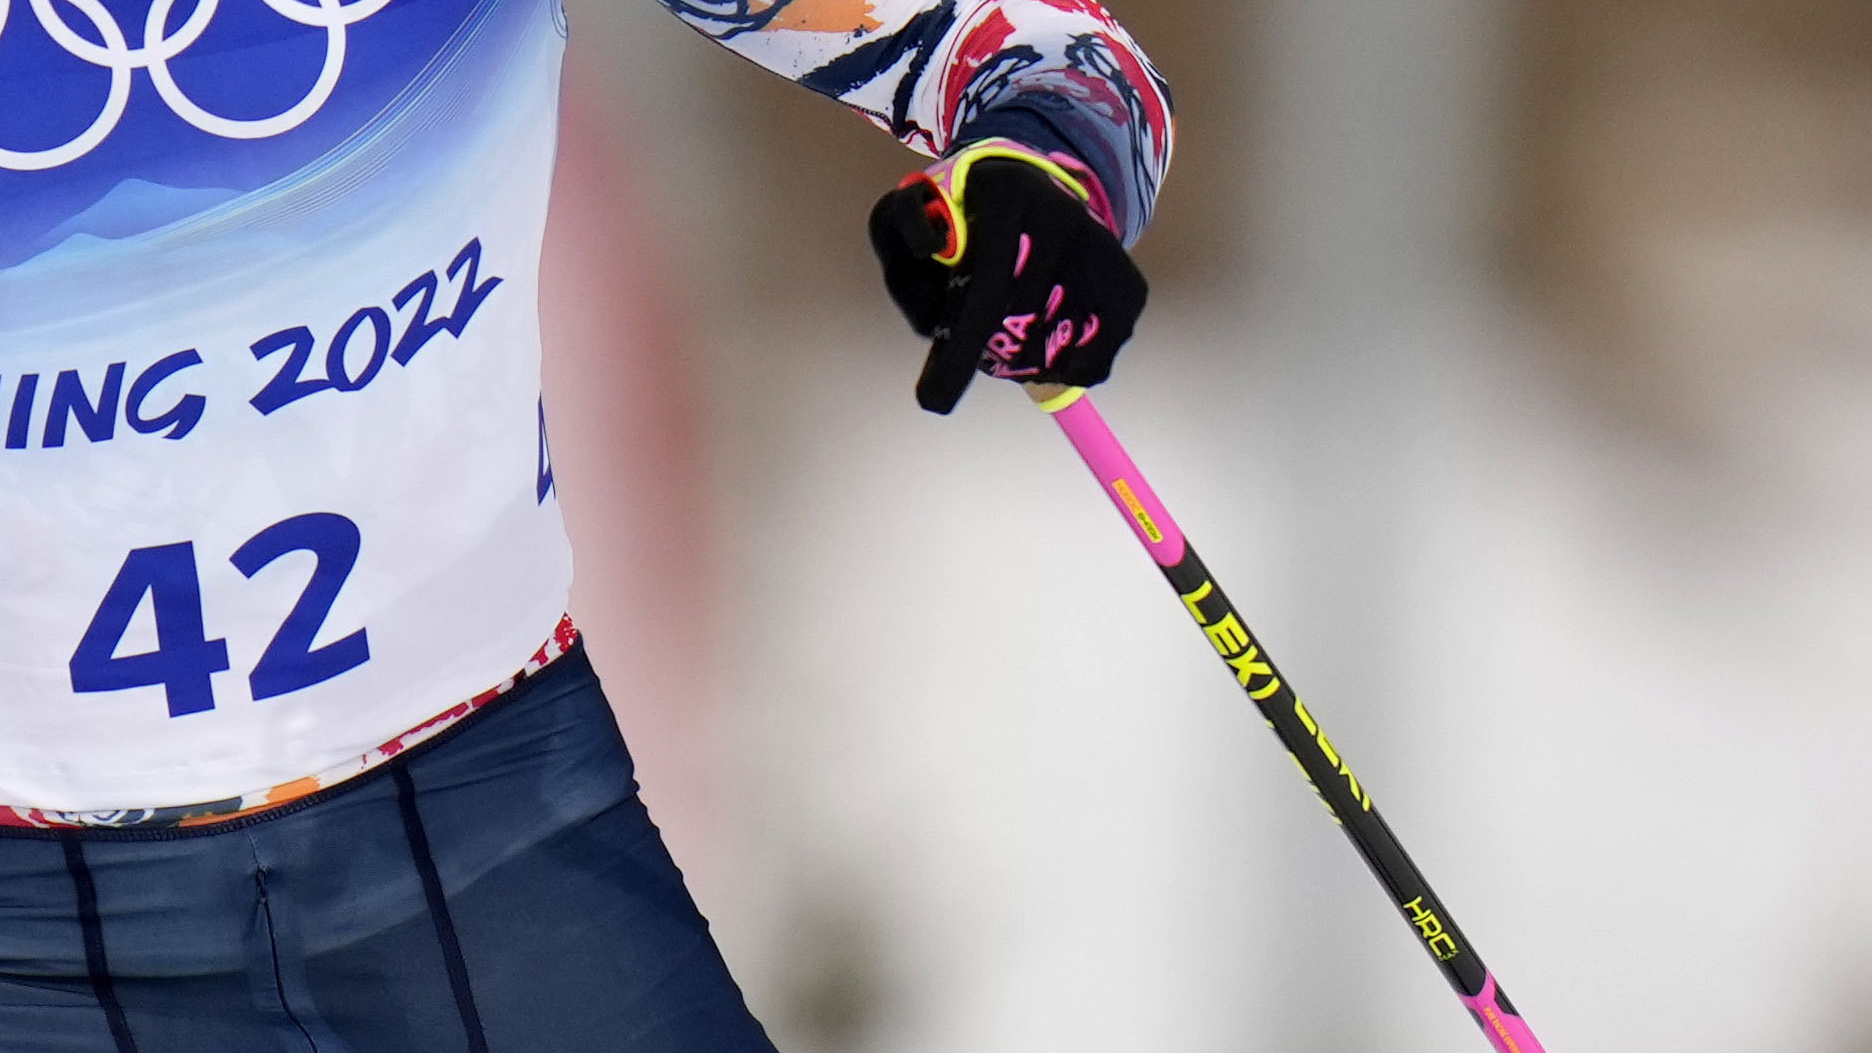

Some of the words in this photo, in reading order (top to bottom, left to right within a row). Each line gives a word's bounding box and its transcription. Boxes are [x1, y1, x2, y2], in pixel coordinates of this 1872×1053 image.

[250, 236, 504, 417] 2022
[70, 511, 371, 718] 42
[1403, 896, 1456, 959] HRC
